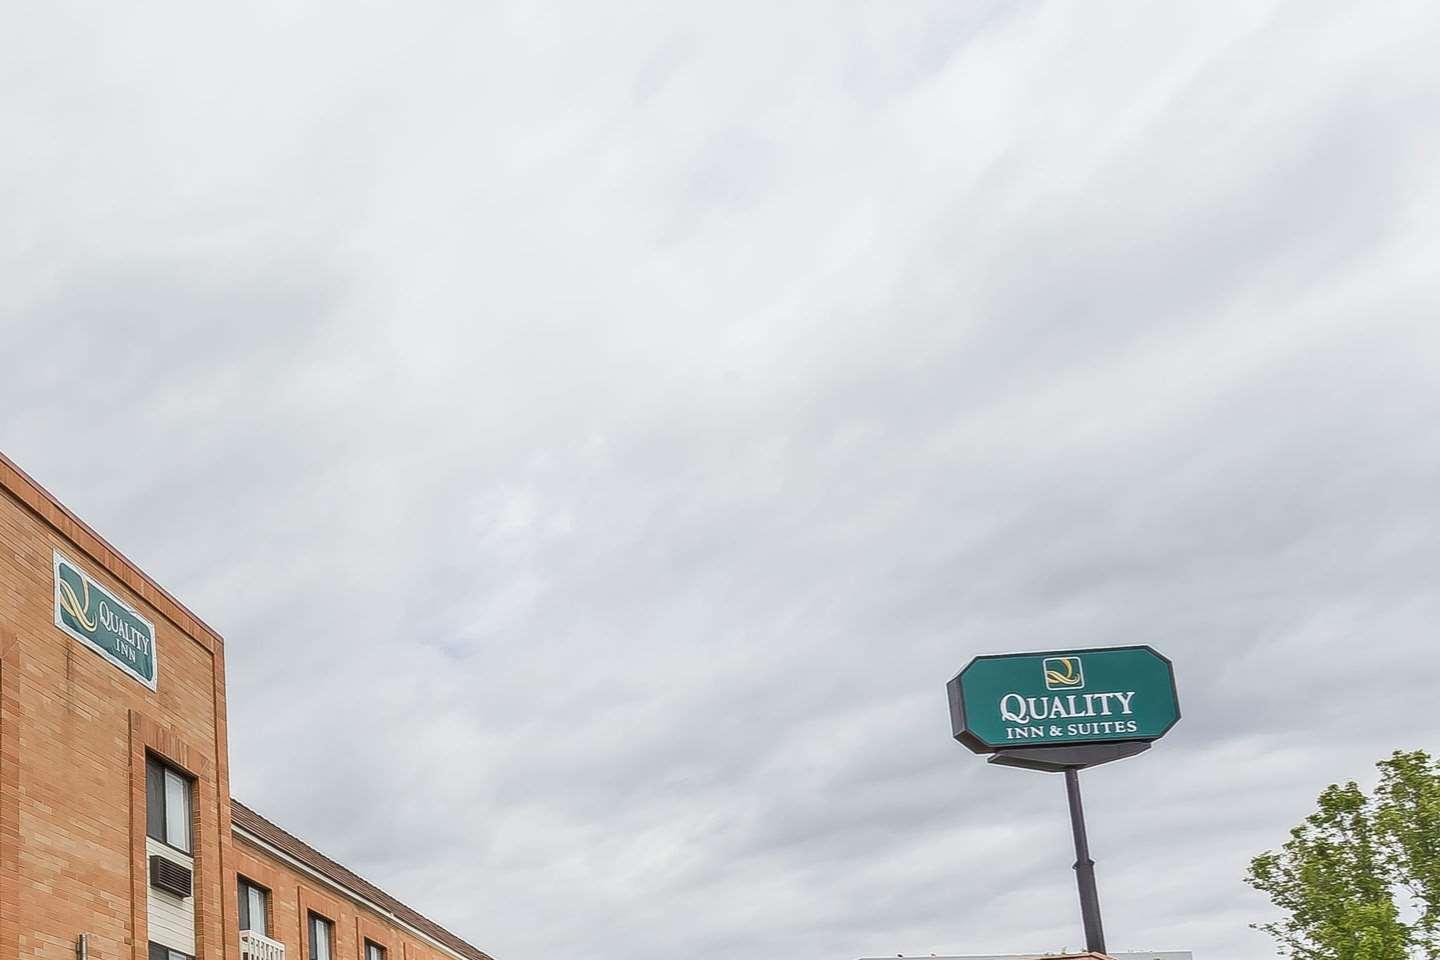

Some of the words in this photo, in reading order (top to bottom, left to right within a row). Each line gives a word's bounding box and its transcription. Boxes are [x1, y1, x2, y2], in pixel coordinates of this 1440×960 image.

[99, 601, 150, 655] QUALITY
[115, 638, 136, 663] INN
[1000, 691, 1136, 724] QUALITY
[1007, 726, 1043, 740] INN
[1049, 725, 1063, 737] &
[1068, 720, 1137, 736] SUITES
